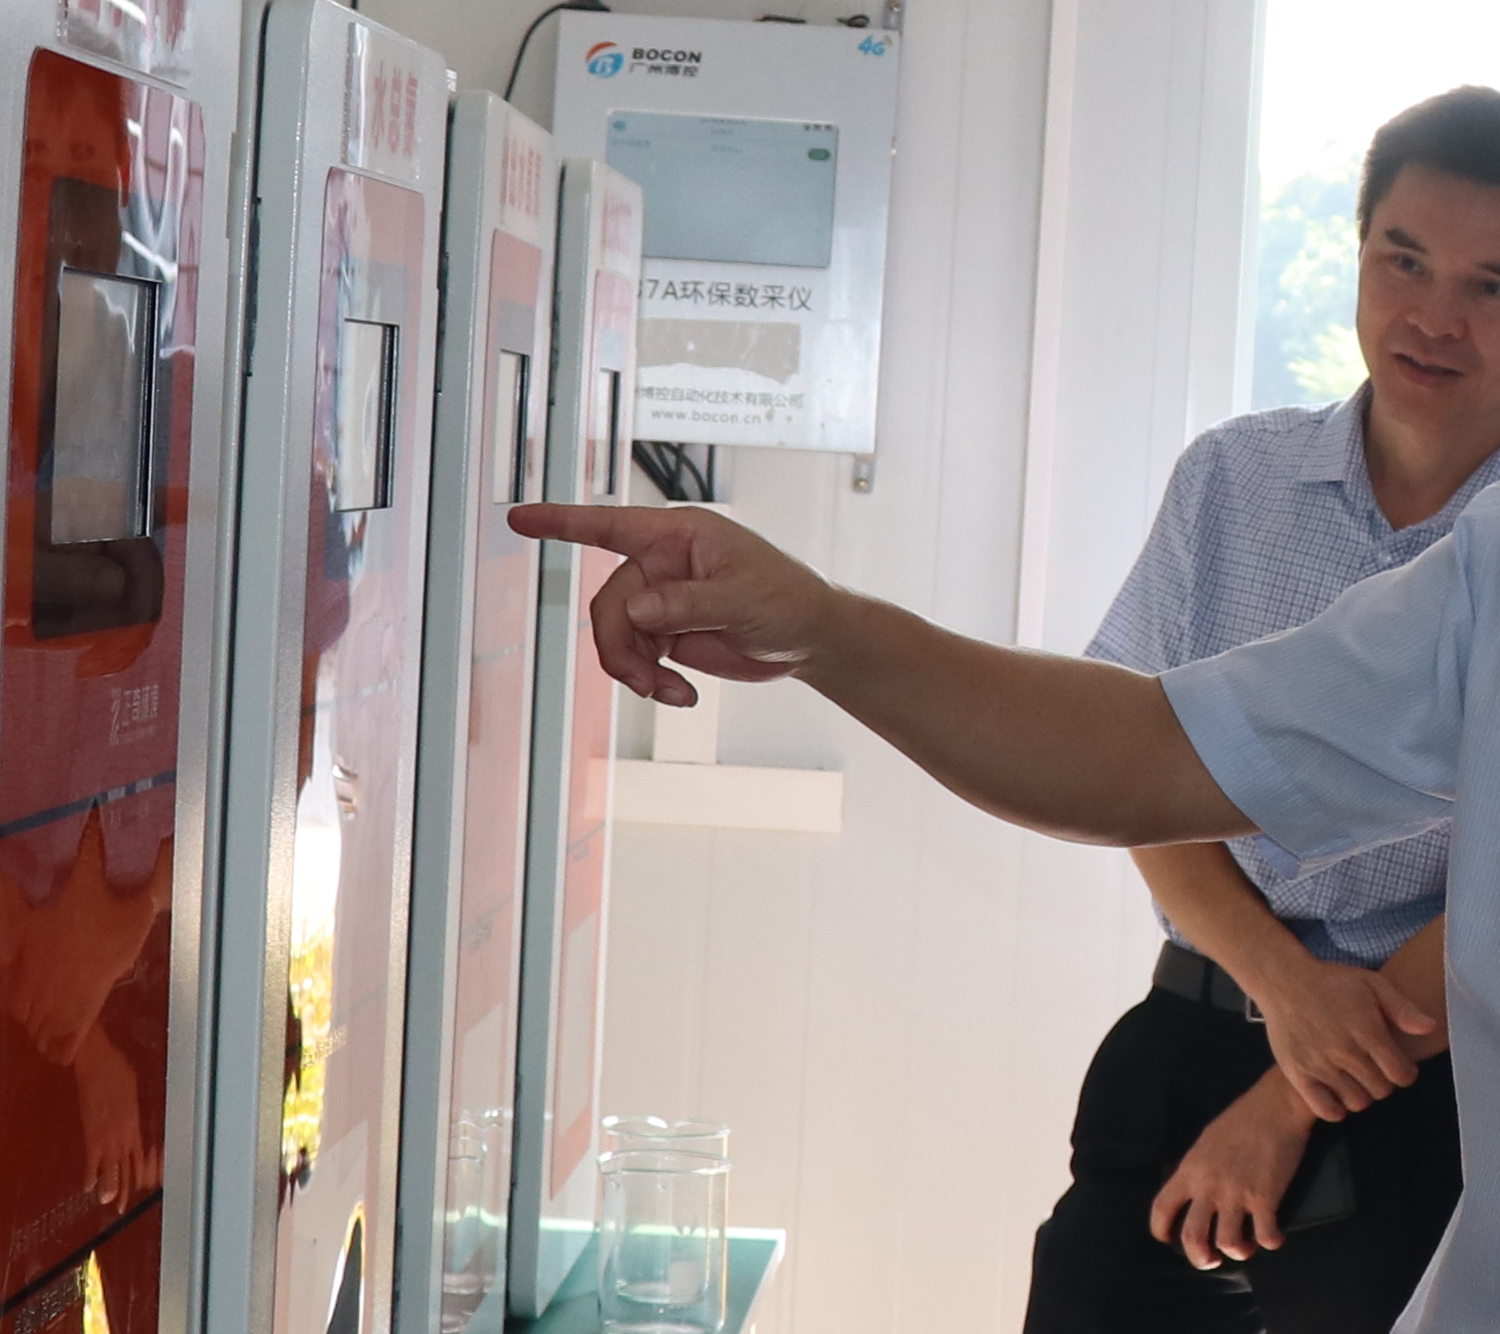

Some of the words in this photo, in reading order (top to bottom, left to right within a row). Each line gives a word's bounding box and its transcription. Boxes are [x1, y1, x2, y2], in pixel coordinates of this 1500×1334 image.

[858, 36, 887, 56] 4G
[632, 48, 702, 63] BOCON
[629, 61, 700, 78] 广州博控
[372, 60, 419, 159] 水总氮
[636, 386, 804, 408] 博控自动化技术有限公司
[651, 409, 762, 425] www.bocon.cn
